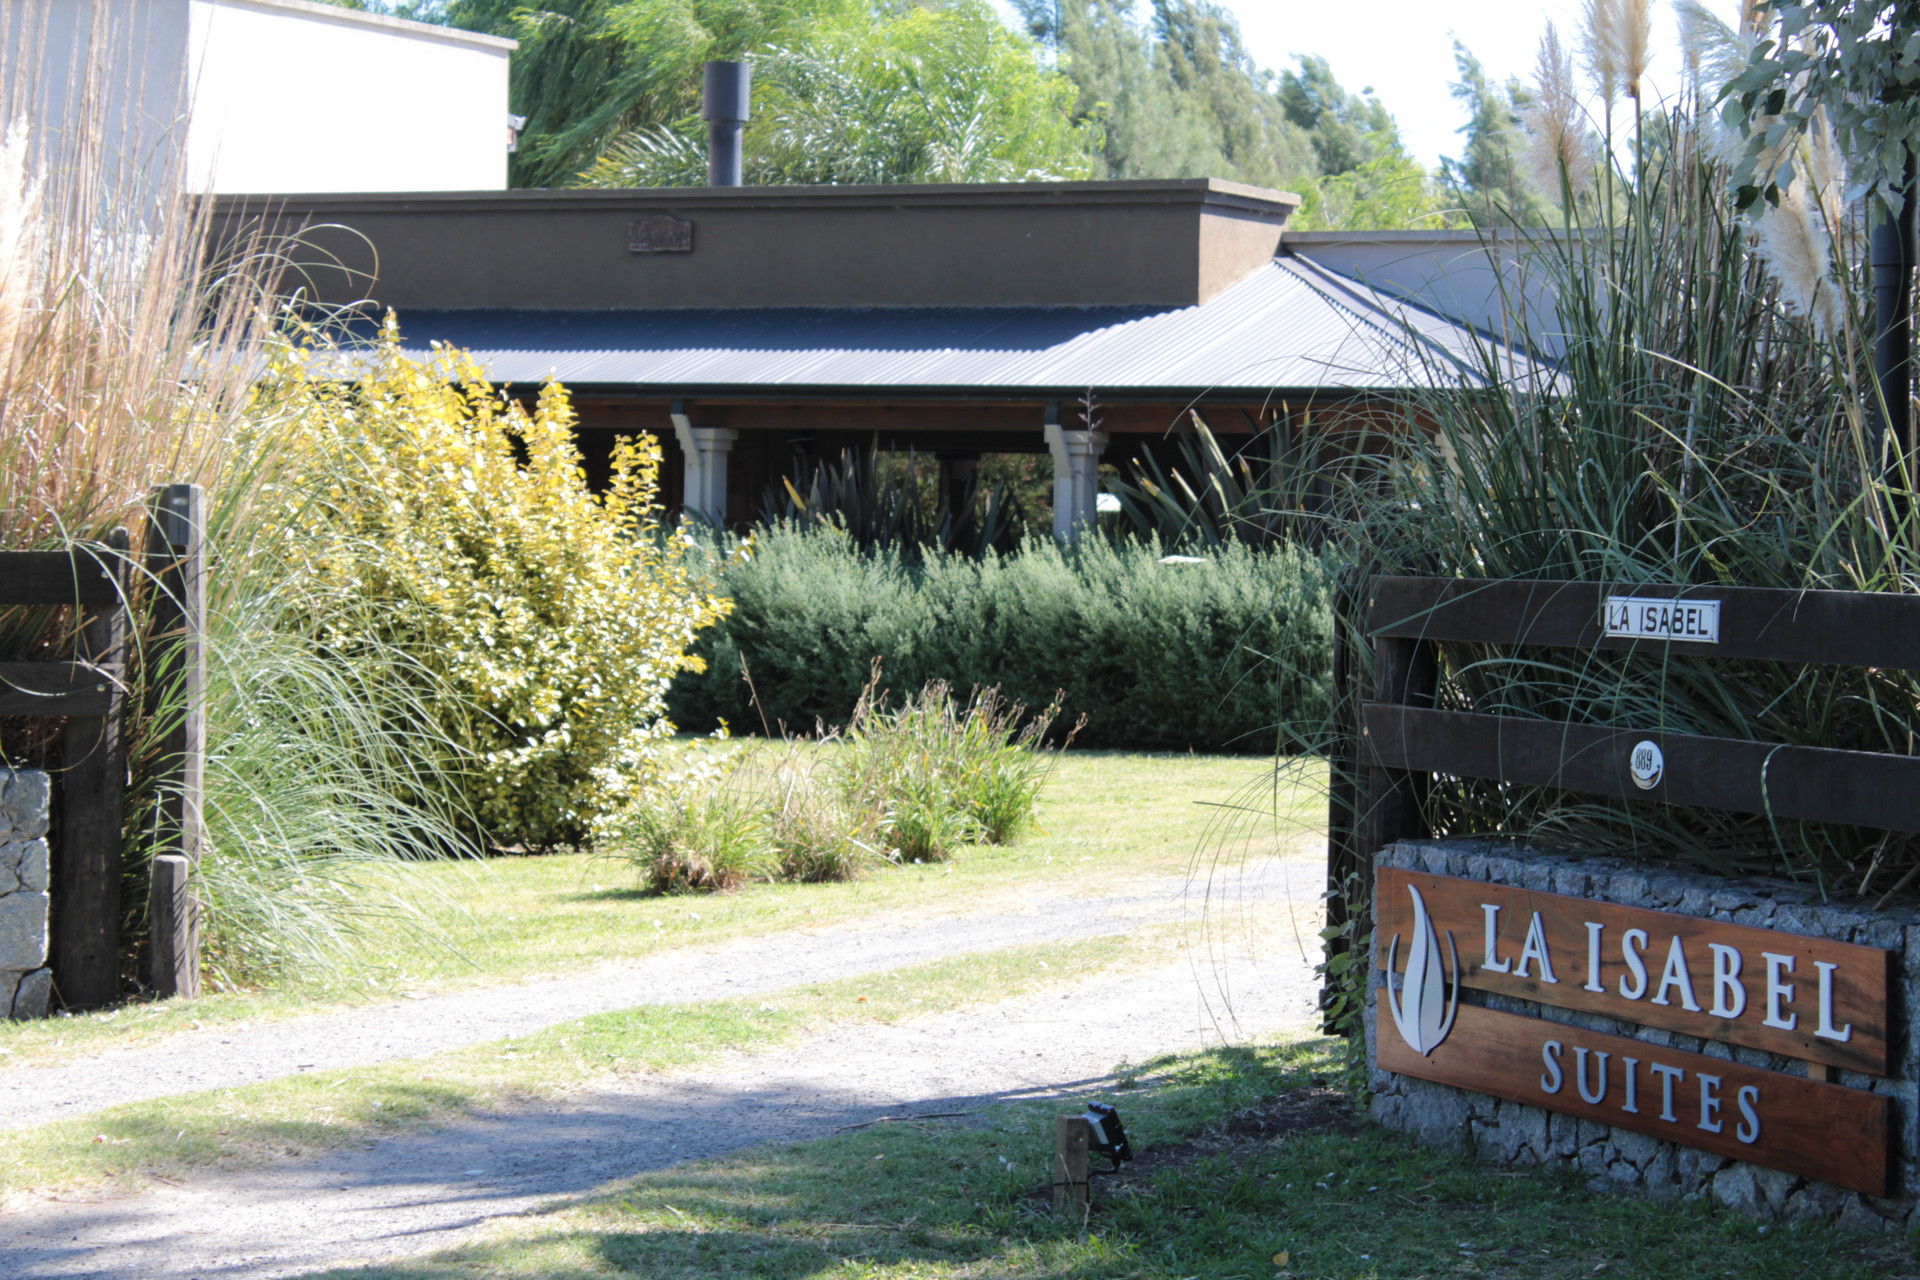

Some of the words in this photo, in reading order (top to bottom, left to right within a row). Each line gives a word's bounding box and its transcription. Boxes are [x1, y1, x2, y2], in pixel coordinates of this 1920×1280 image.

[1609, 604, 1630, 631] LA
[1640, 606, 1708, 636] ISABEL
[1635, 748, 1653, 770] 889
[1480, 903, 1559, 984] LA
[1583, 921, 1851, 1043] ISABEL
[1540, 1040, 1762, 1144] SUITES
